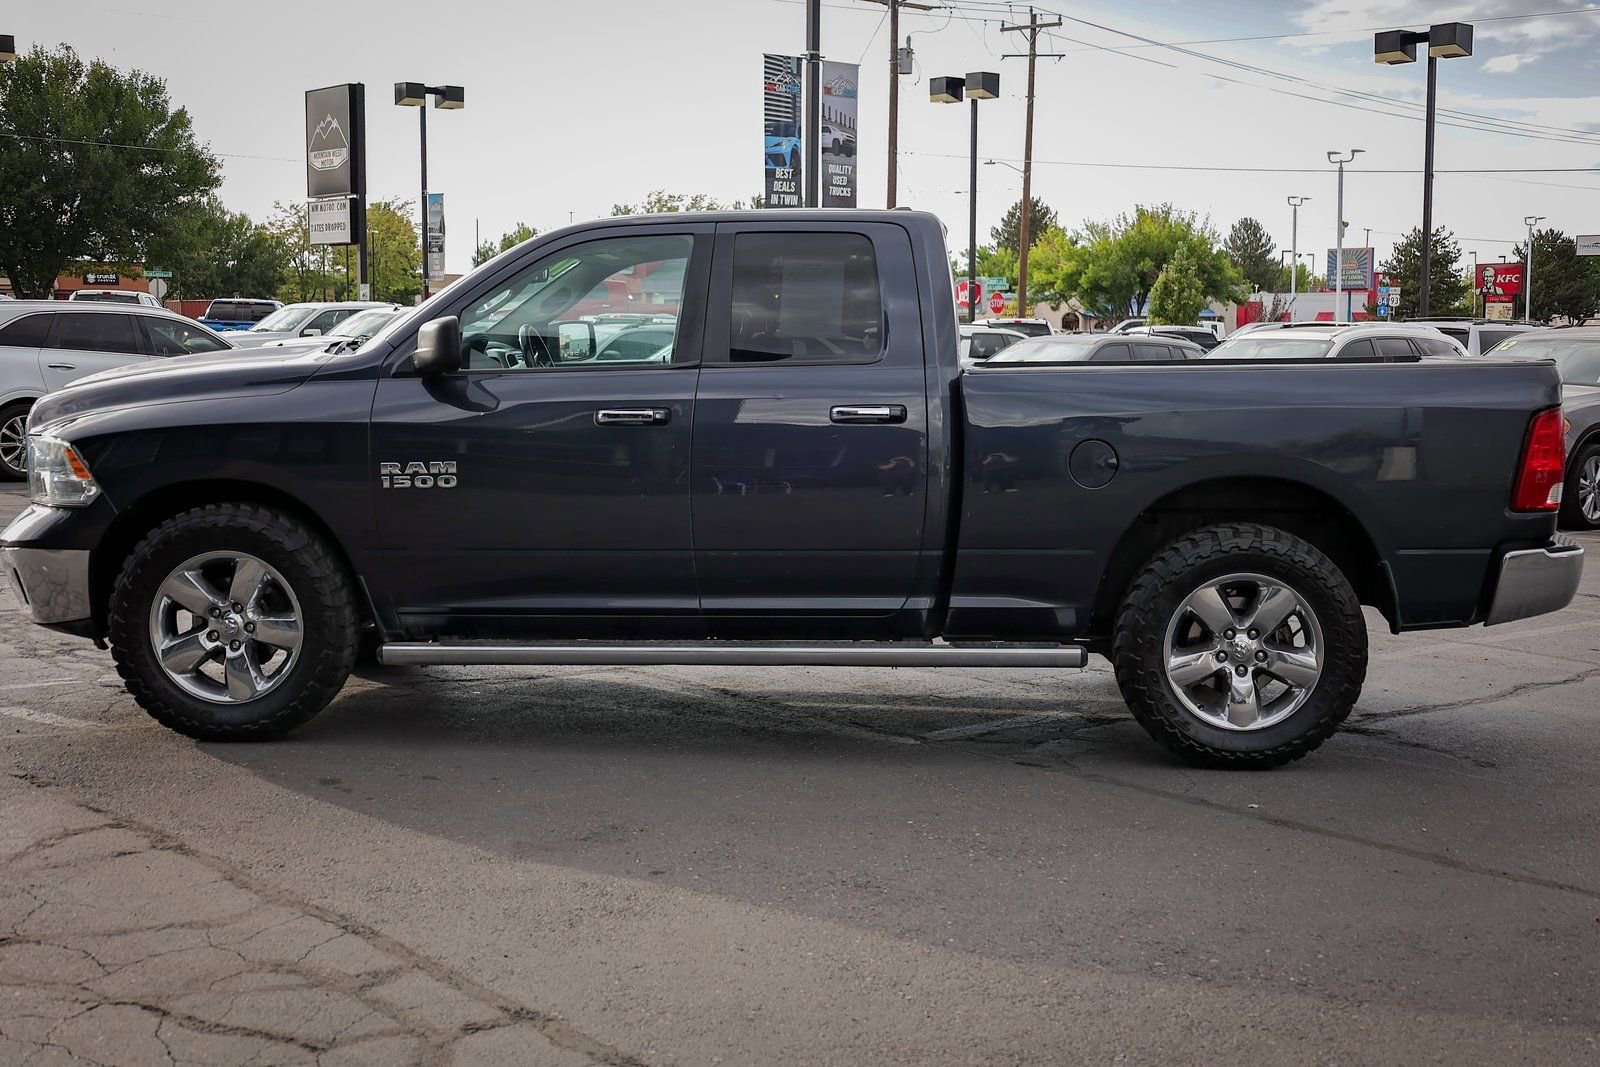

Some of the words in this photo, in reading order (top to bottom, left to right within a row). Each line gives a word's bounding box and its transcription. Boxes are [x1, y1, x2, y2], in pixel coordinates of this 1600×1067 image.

[313, 151, 332, 160] MOUNTAIN
[775, 168, 793, 179] BEST
[828, 164, 853, 175] QUALITY
[832, 175, 847, 186] USED
[773, 181, 796, 192] DEALS
[829, 186, 852, 197] TRUCKS
[770, 193, 778, 205] IN
[780, 194, 799, 206] TWIN
[1496, 274, 1520, 283] KFC
[990, 298, 1004, 308] STOP
[1377, 296, 1387, 306] 84
[1390, 296, 1399, 305] 93
[380, 461, 457, 474] RAM
[381, 475, 457, 488] 1500
